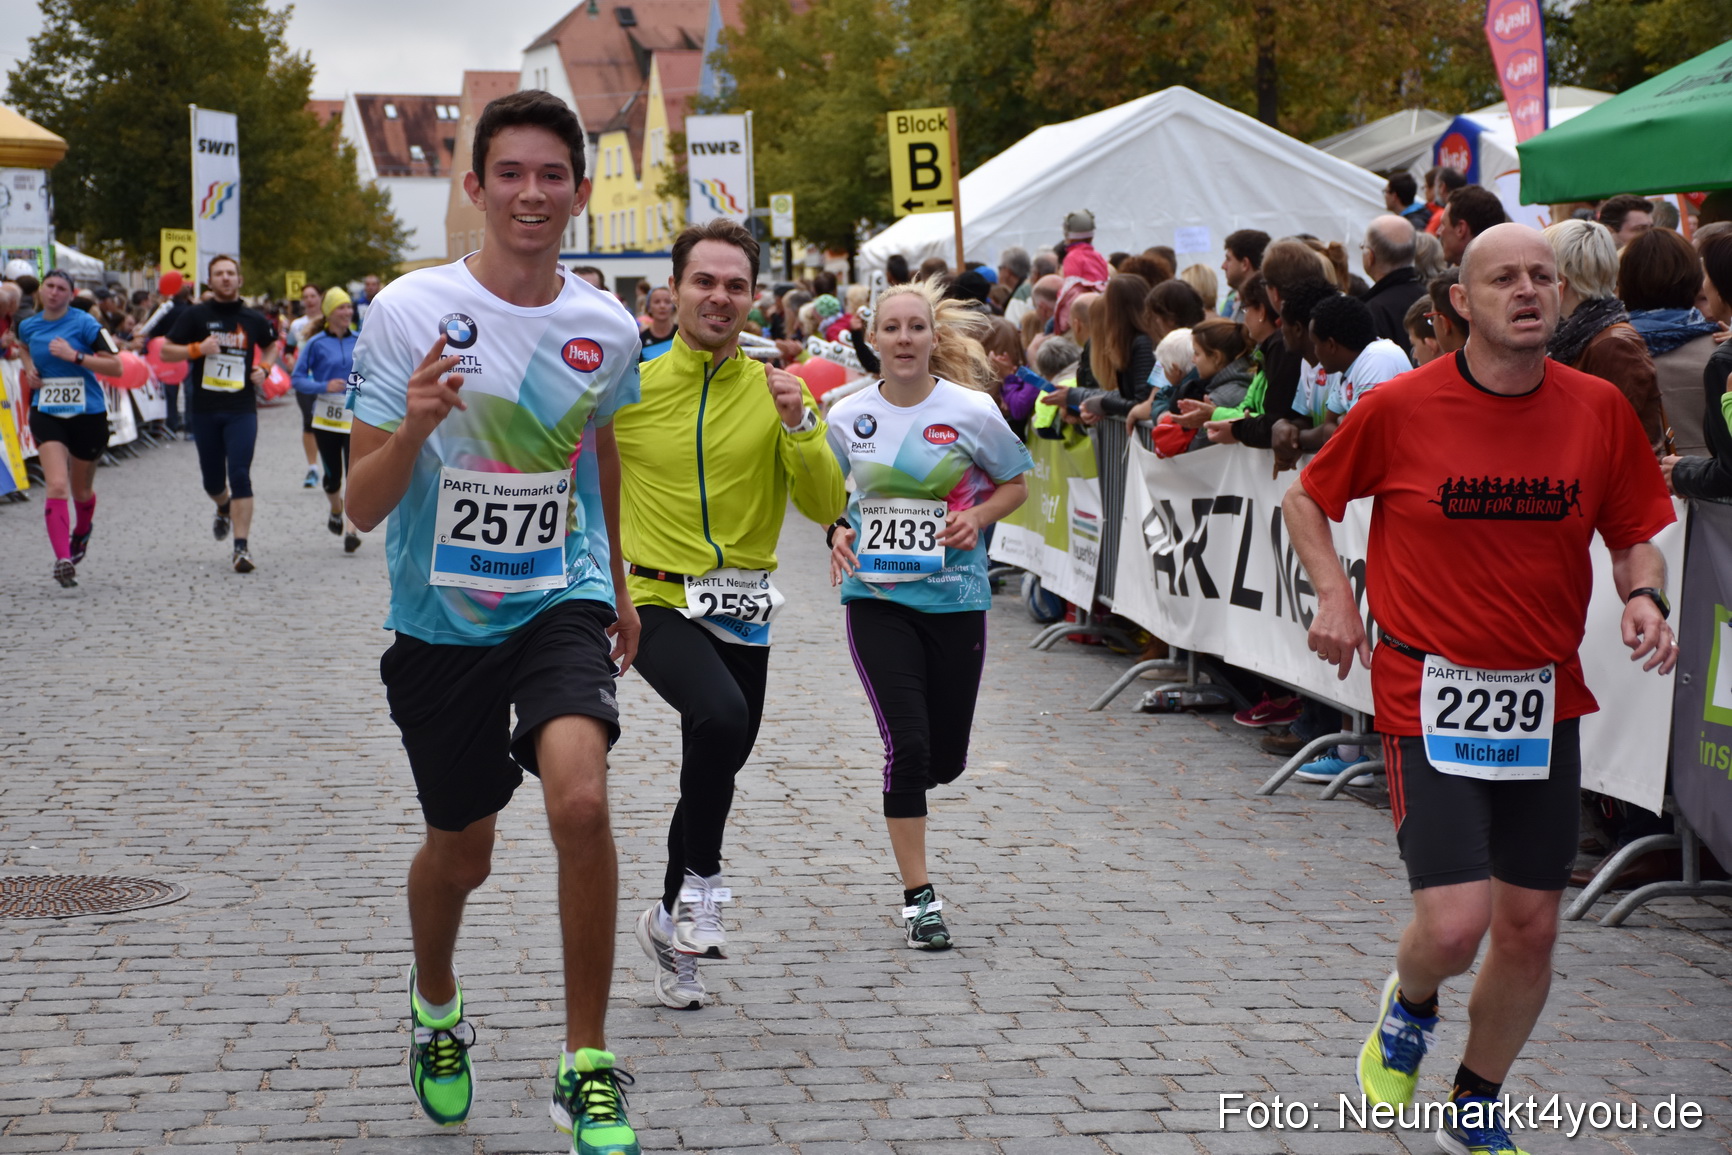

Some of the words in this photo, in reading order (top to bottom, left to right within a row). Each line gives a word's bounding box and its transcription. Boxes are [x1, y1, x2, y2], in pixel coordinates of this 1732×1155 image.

[897, 114, 948, 134] Block
[198, 138, 236, 156] swn
[908, 142, 943, 192] B
[165, 232, 192, 243] Block
[169, 246, 187, 269] C
[441, 314, 474, 326] BMW
[440, 354, 482, 366] PRTL
[568, 344, 599, 365] Hervis
[217, 363, 232, 378] 71
[446, 366, 483, 375] eumarkt
[44, 388, 81, 403] 2282
[326, 406, 342, 420] 86
[928, 428, 955, 440] Hervis
[443, 479, 490, 495] PARTL
[494, 485, 554, 497] Neumarkt
[862, 506, 888, 515] PARTL
[889, 506, 930, 516] Neumarkt
[1448, 498, 1480, 513] RUN
[1484, 496, 1513, 515] FOR
[1515, 497, 1563, 515] BÜRNI
[451, 499, 559, 546] 2579
[440, 535, 446, 543] C
[867, 519, 936, 552] 2433
[470, 554, 535, 576] Samuel
[873, 558, 921, 572] Ramona
[688, 578, 724, 589] PARTL
[699, 592, 773, 622] 2597
[1427, 666, 1473, 681] PARTL
[1476, 671, 1535, 683] Neumarkt
[1436, 686, 1544, 733] 2239
[1455, 742, 1520, 763] Michael
